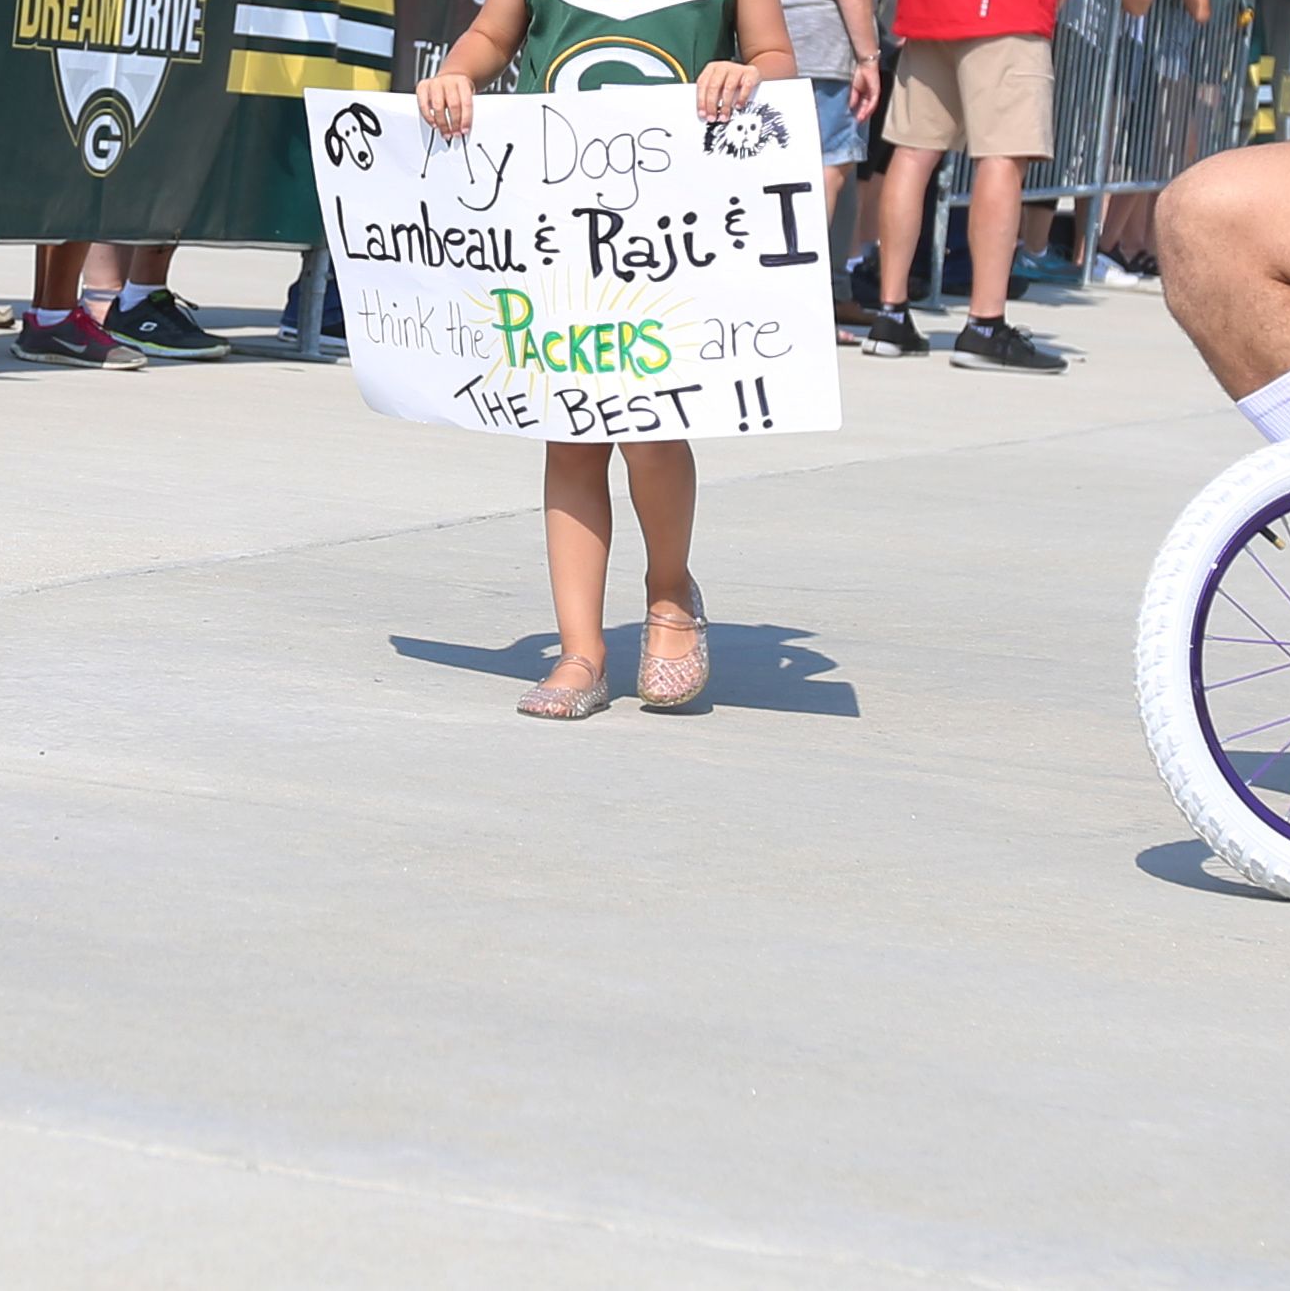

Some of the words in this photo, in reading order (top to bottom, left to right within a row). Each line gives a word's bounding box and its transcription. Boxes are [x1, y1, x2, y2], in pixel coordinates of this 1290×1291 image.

[420, 126, 514, 211] My
[542, 104, 672, 210] Dogs
[335, 196, 527, 273] Lambeau
[571, 208, 717, 283] Raji
[759, 182, 819, 268] I
[358, 289, 440, 356] think
[446, 300, 492, 360] the
[490, 288, 672, 379] PACKERS
[699, 318, 794, 361] are
[454, 376, 539, 430] THE
[554, 384, 702, 436] BEST
